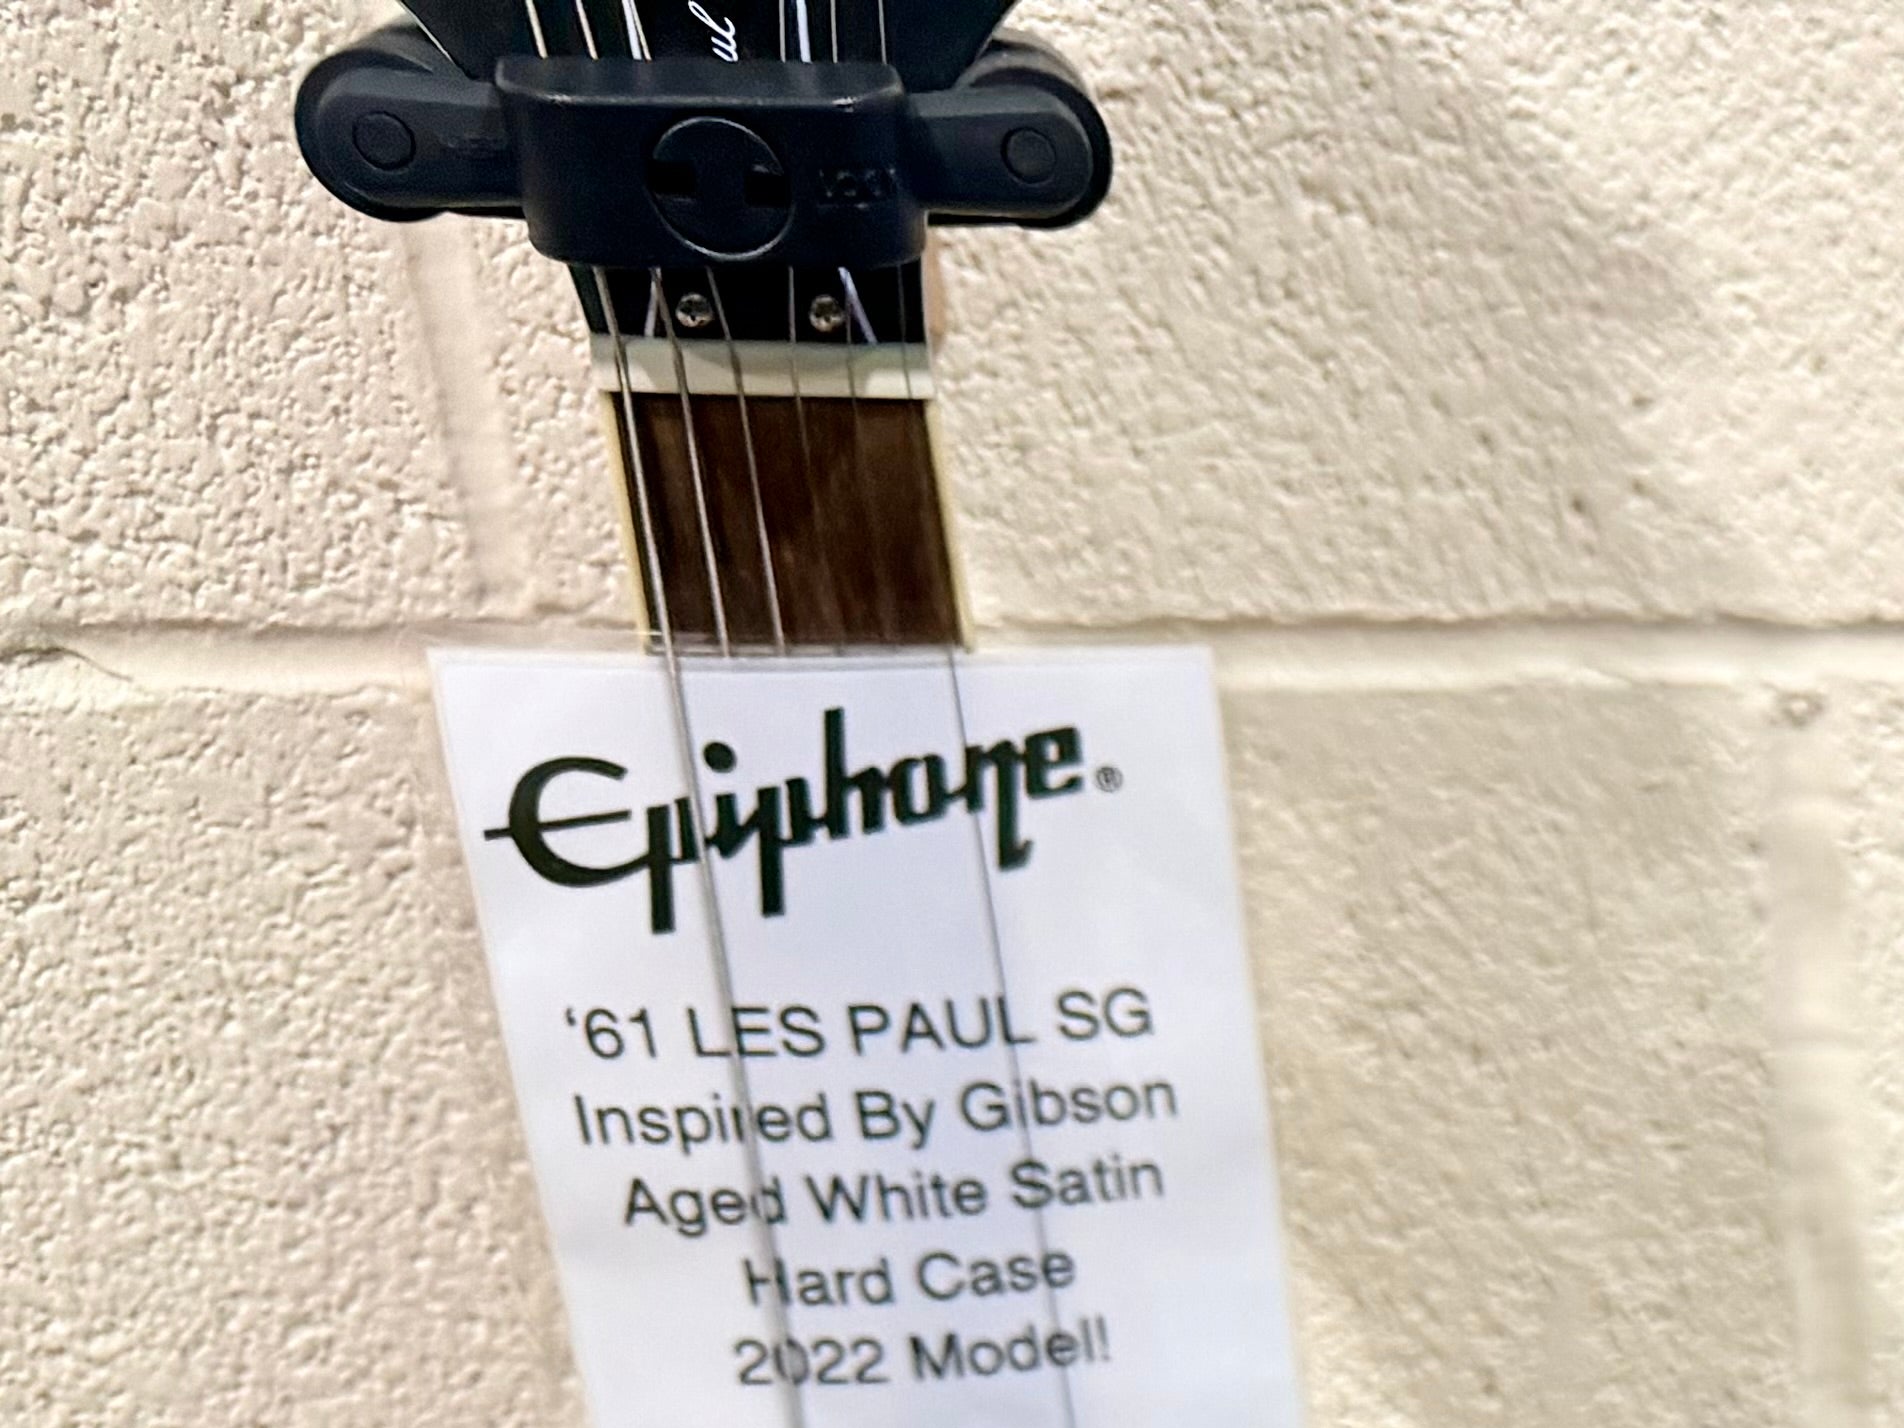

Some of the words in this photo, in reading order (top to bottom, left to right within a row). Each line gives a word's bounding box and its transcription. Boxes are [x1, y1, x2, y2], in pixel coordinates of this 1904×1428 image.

[688, 1003, 826, 1060] LES
[849, 996, 1033, 1056] PAUL
[1057, 987, 1153, 1042] SG
[572, 1091, 833, 1159] Inspired
[857, 1090, 937, 1150] By
[960, 1075, 1178, 1134] Gibson
[622, 1172, 785, 1239] Aged
[806, 1163, 988, 1226] White
[1009, 1156, 1165, 1212] Satin
[743, 1253, 895, 1307] Hard
[916, 1245, 1077, 1299] Case
[735, 1334, 889, 1389] 2022
[909, 1316, 1113, 1379] Model!
